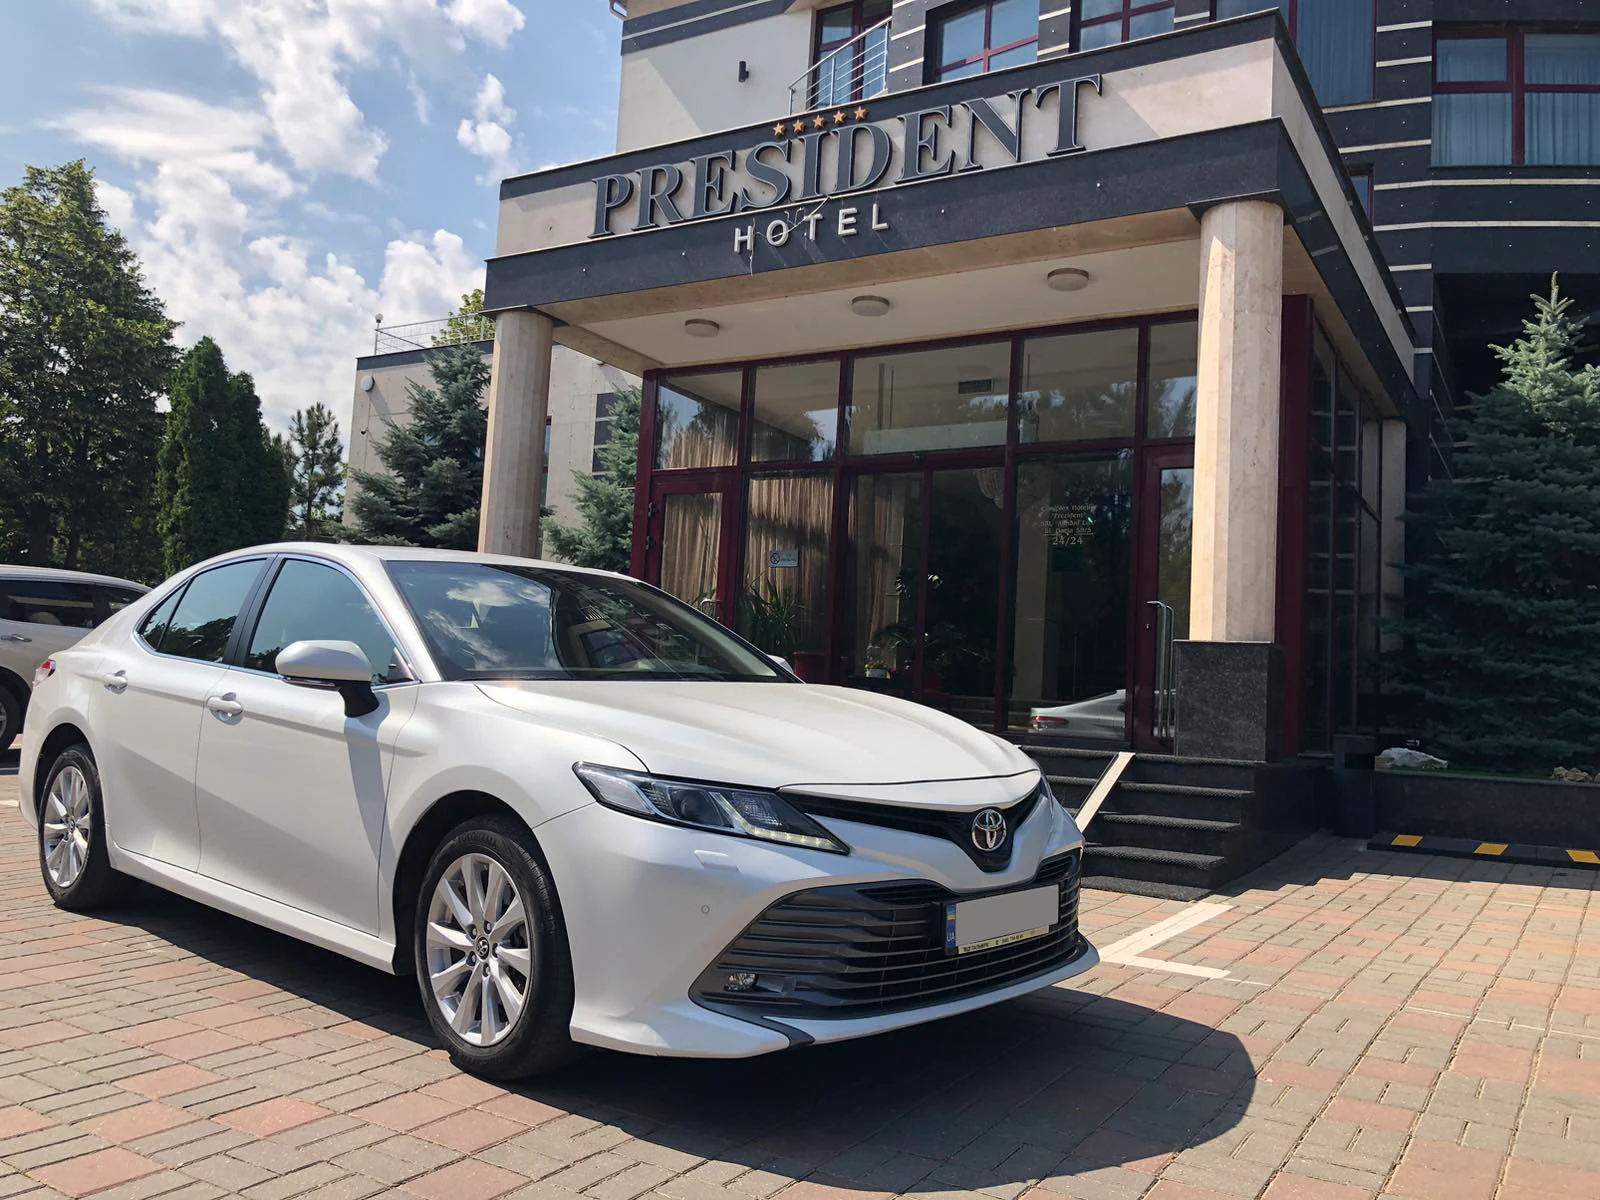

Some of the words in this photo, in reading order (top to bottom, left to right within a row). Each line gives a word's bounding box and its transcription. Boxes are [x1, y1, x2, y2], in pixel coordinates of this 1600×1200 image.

[587, 74, 1103, 239] PRESIDENT
[733, 203, 889, 254] HOTEL
[1052, 535, 1083, 546] 24/24
